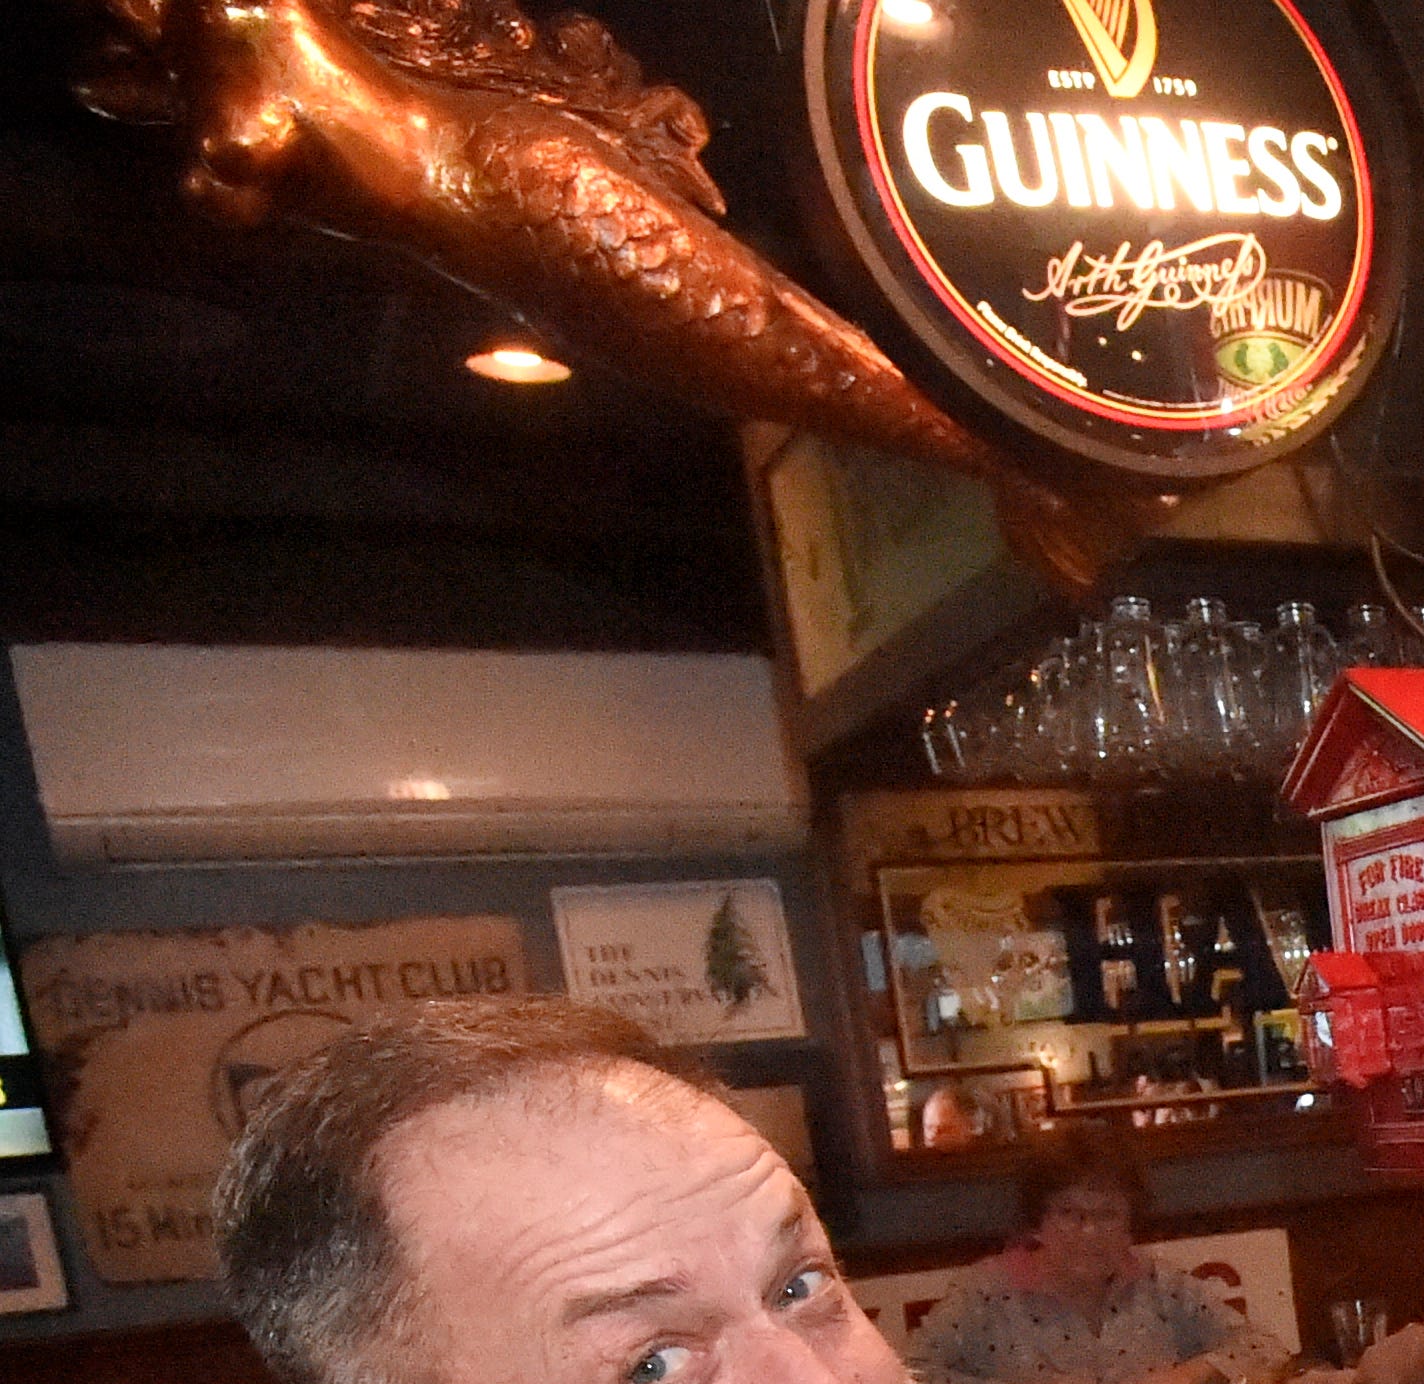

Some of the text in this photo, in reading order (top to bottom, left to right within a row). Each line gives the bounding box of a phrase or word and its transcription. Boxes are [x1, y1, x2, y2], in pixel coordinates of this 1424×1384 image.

[902, 92, 1342, 220] GUINNESS
[236, 962, 395, 1004] YACHT
[398, 955, 512, 998] CLUB
